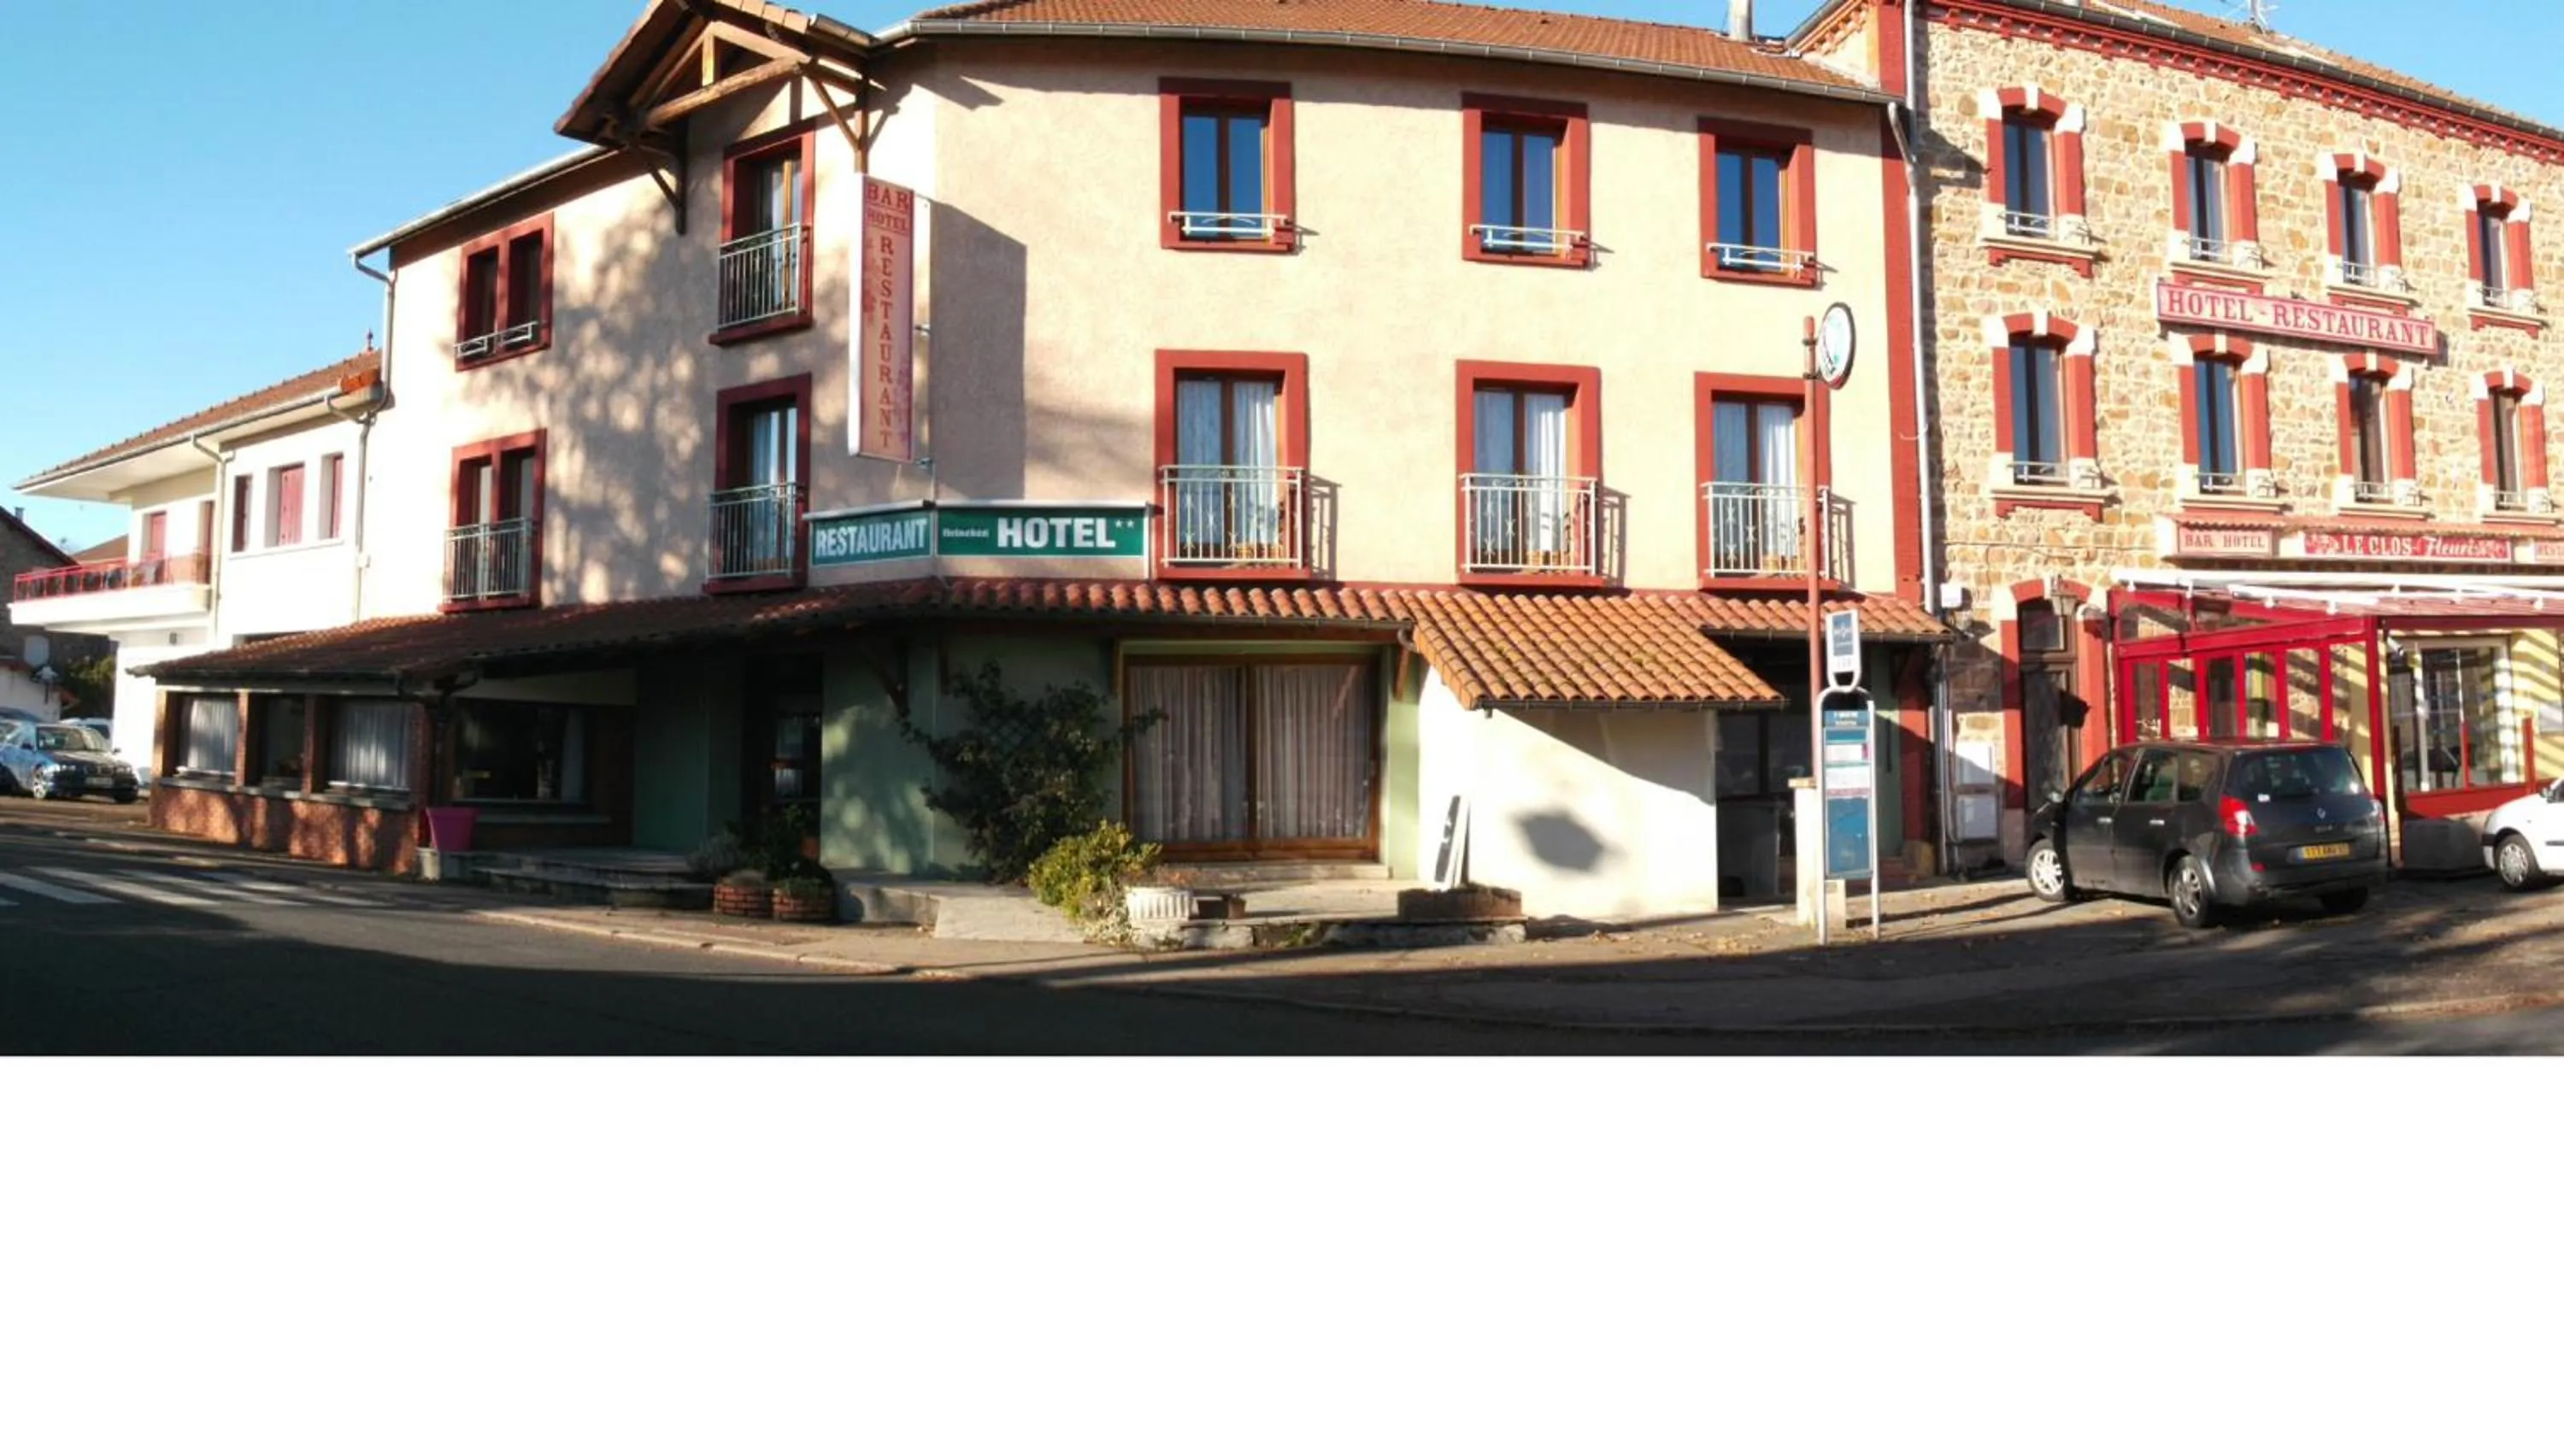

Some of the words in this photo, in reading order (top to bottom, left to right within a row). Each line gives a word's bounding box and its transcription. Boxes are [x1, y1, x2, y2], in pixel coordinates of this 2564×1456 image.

[867, 183, 909, 210] BAR
[867, 208, 909, 231] HOTEL
[2167, 290, 2254, 323] HOTEL
[2273, 303, 2430, 347] RESTAURANT
[878, 235, 894, 449] RESTAURANT
[814, 518, 928, 557] RESTAURANT
[997, 517, 1116, 549] HOTEL
[2185, 534, 2214, 548] BAR
[2223, 535, 2266, 549] HOTEL
[2342, 534, 2364, 555] LE
[2368, 534, 2413, 556] CLOS
